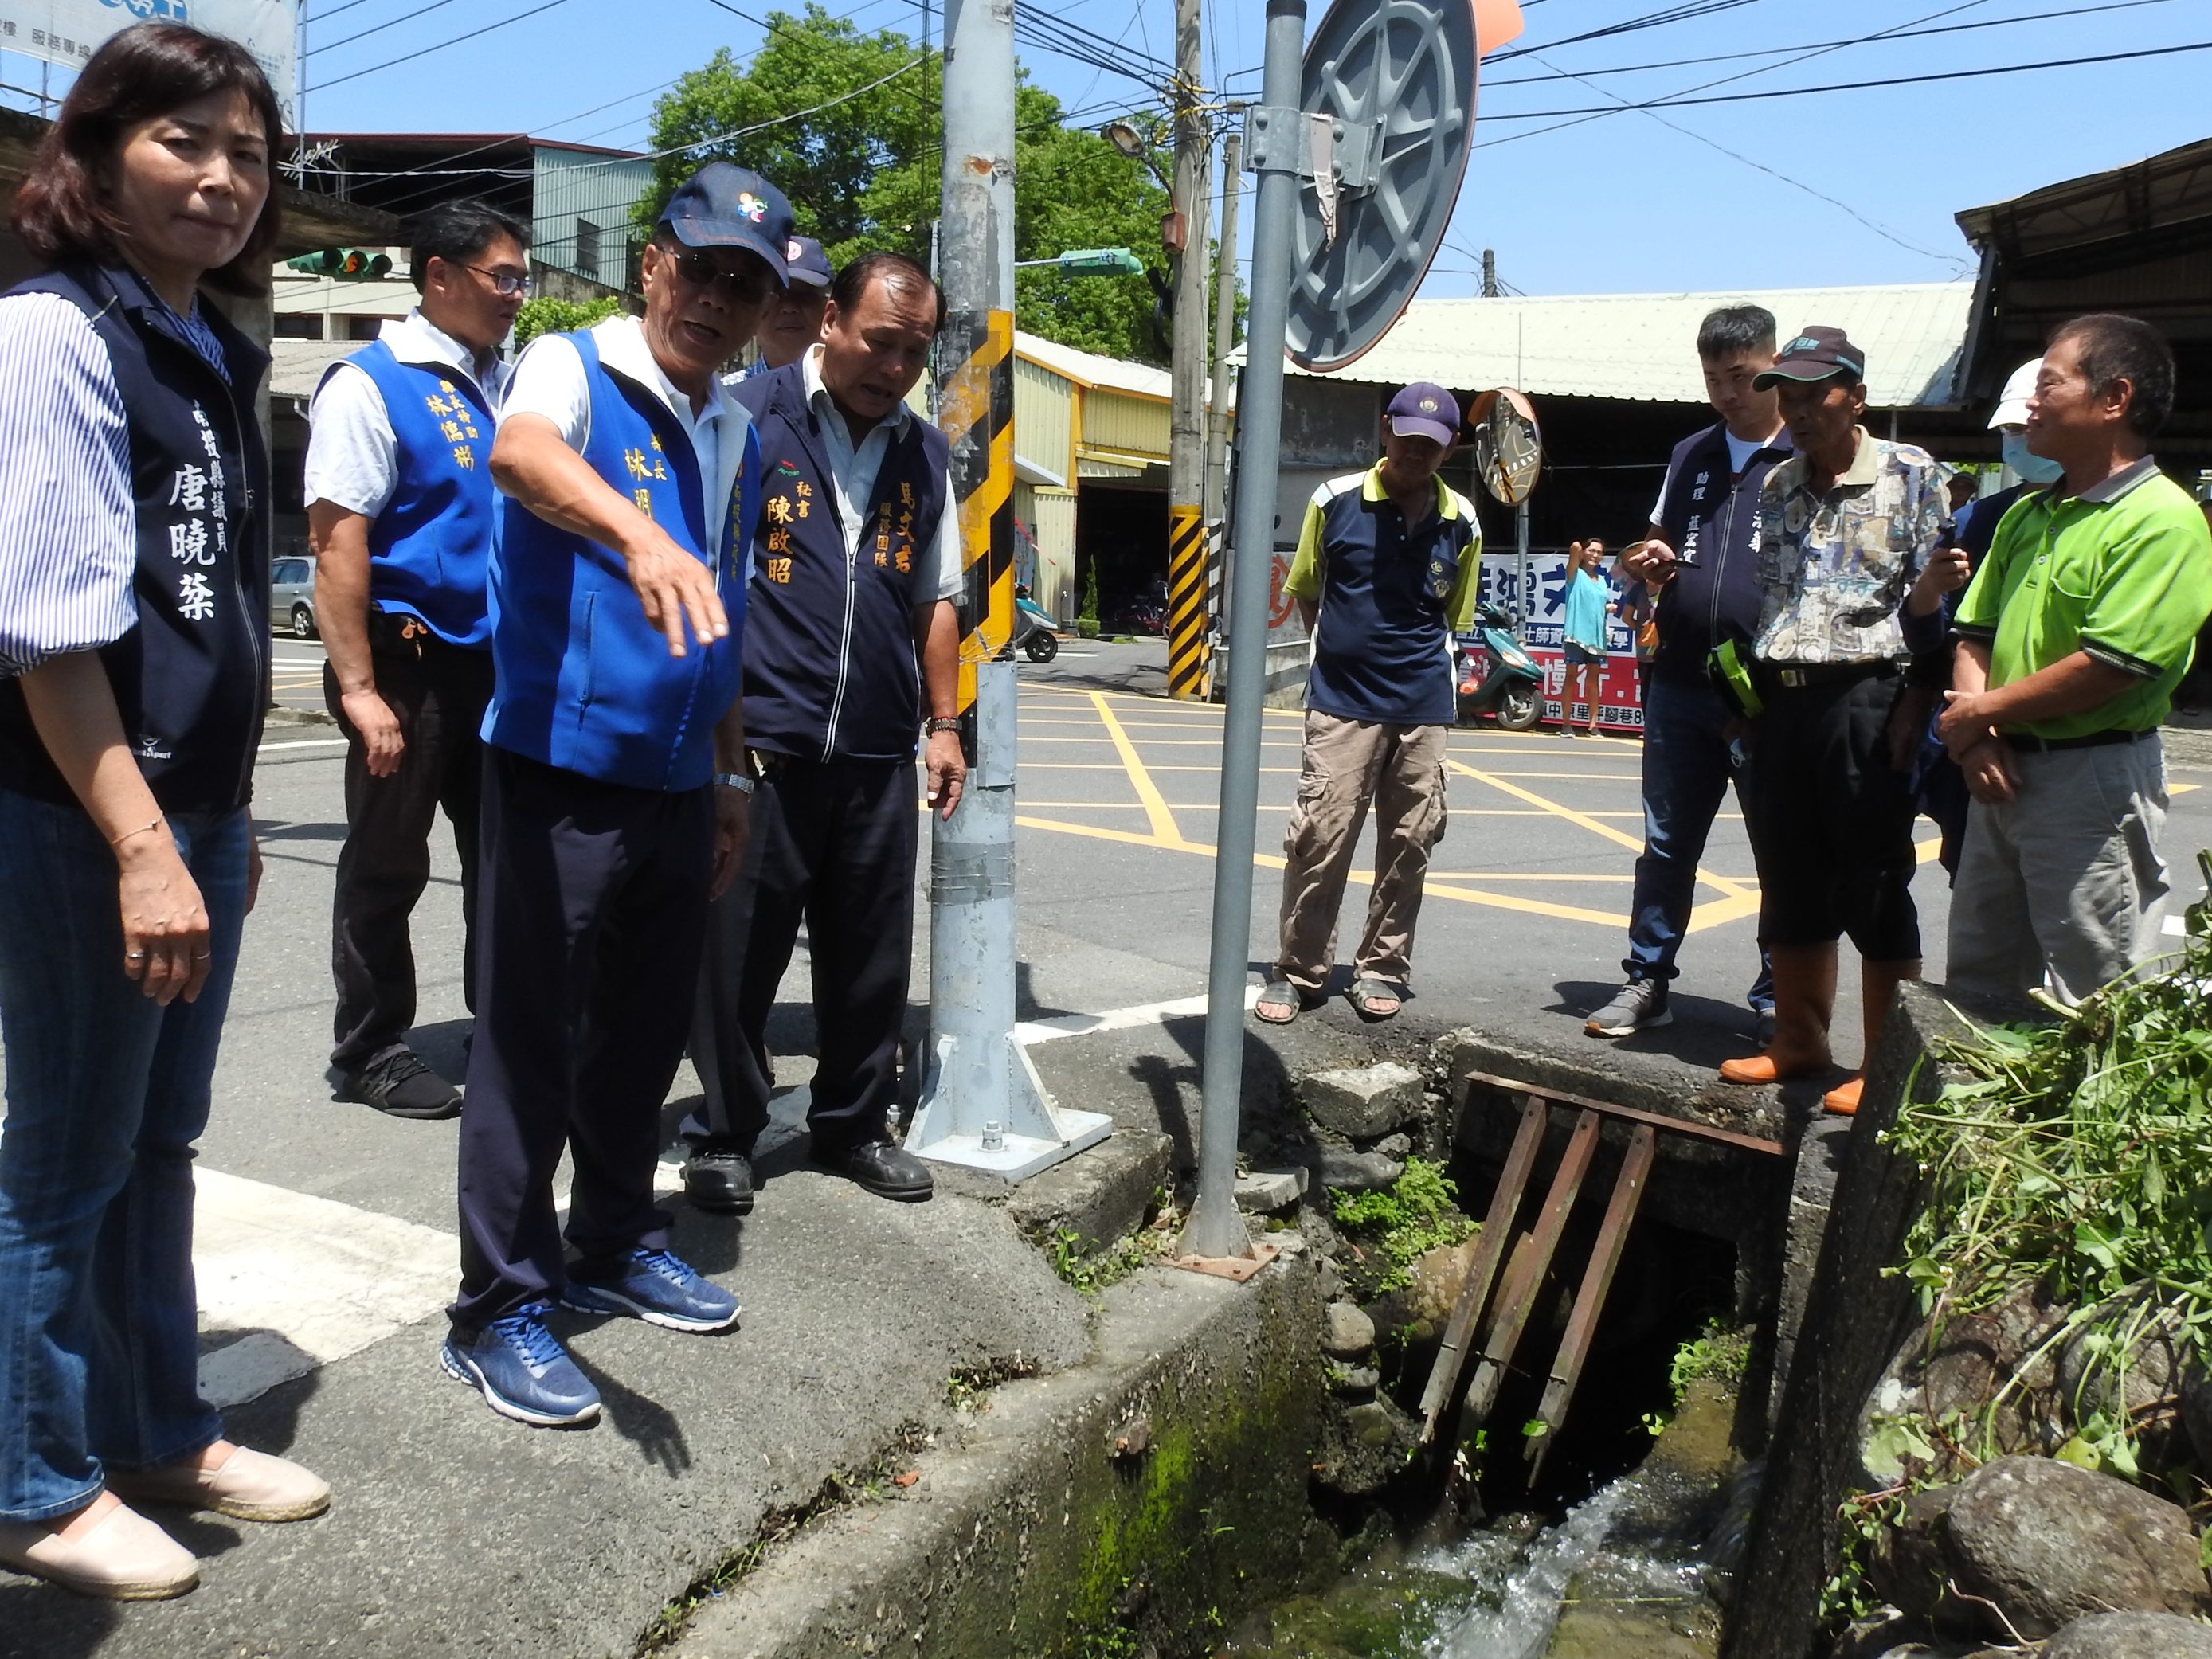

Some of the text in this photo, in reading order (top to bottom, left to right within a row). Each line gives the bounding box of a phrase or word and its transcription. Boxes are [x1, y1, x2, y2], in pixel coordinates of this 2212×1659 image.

[0, 19, 16, 37] 樓
[796, 481, 812, 518] 秘書
[1692, 471, 1709, 500] 助理
[168, 463, 216, 621] 唐曉棻
[875, 502, 892, 567] 服務團隊
[895, 481, 915, 573] 馬文君
